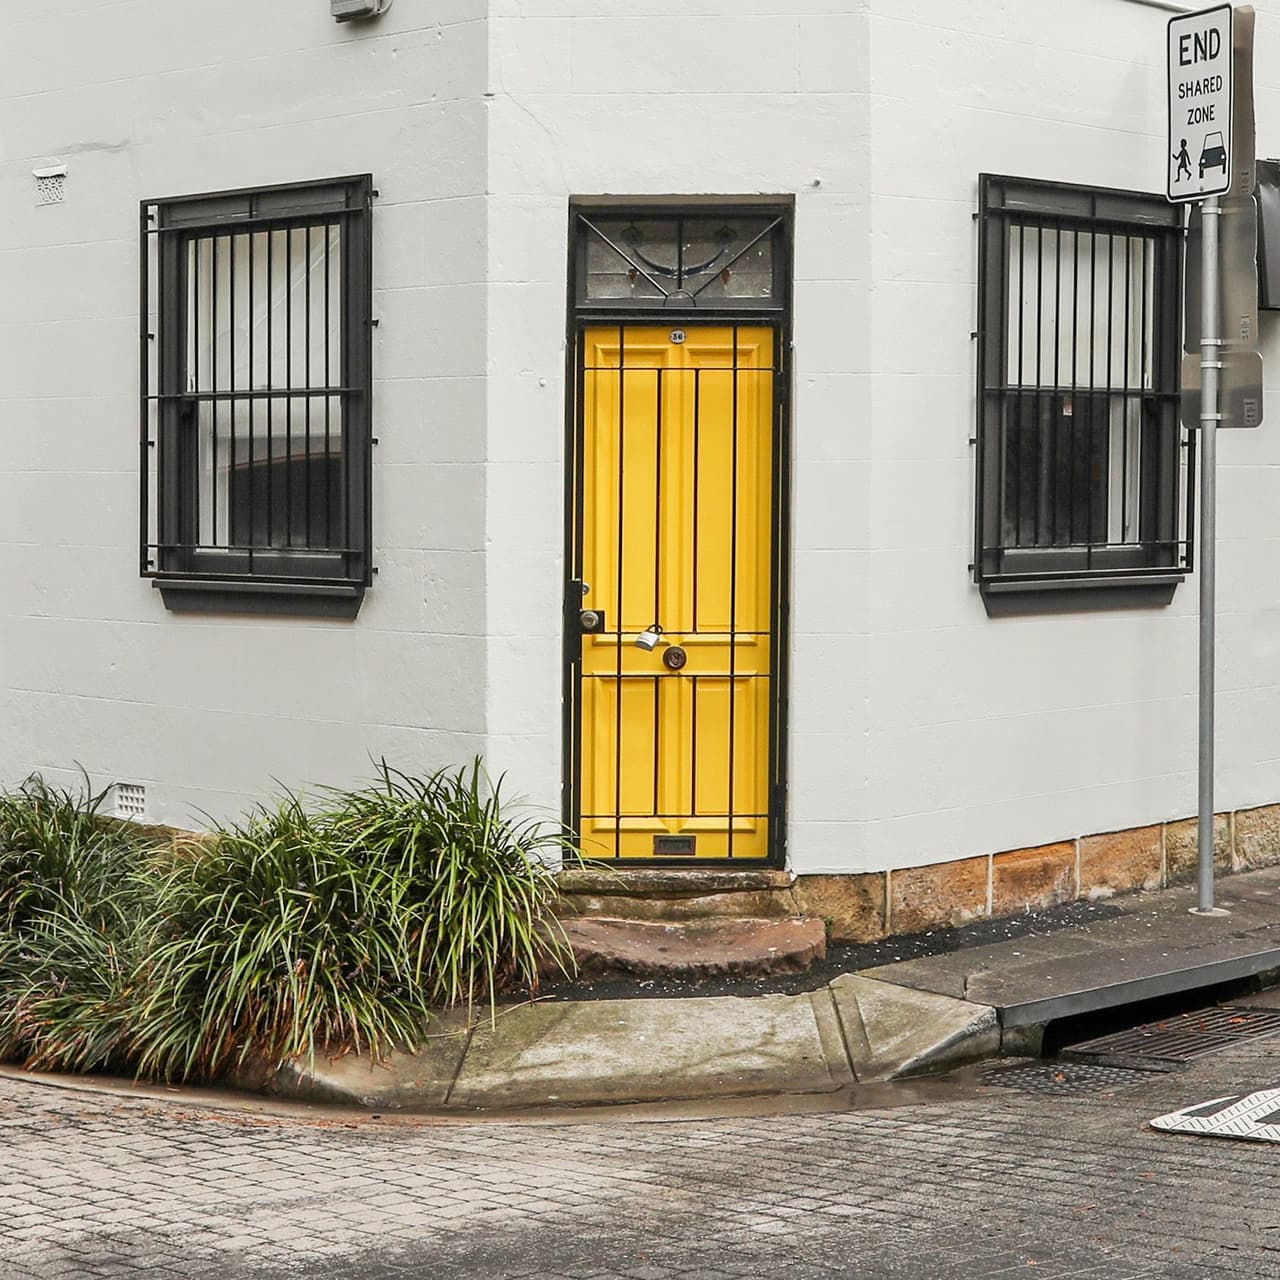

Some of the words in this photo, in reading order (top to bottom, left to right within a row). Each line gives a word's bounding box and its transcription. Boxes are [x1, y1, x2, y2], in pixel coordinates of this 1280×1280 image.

[1179, 27, 1221, 66] END
[1178, 75, 1223, 99] SHARED
[1187, 104, 1215, 126] ZONE
